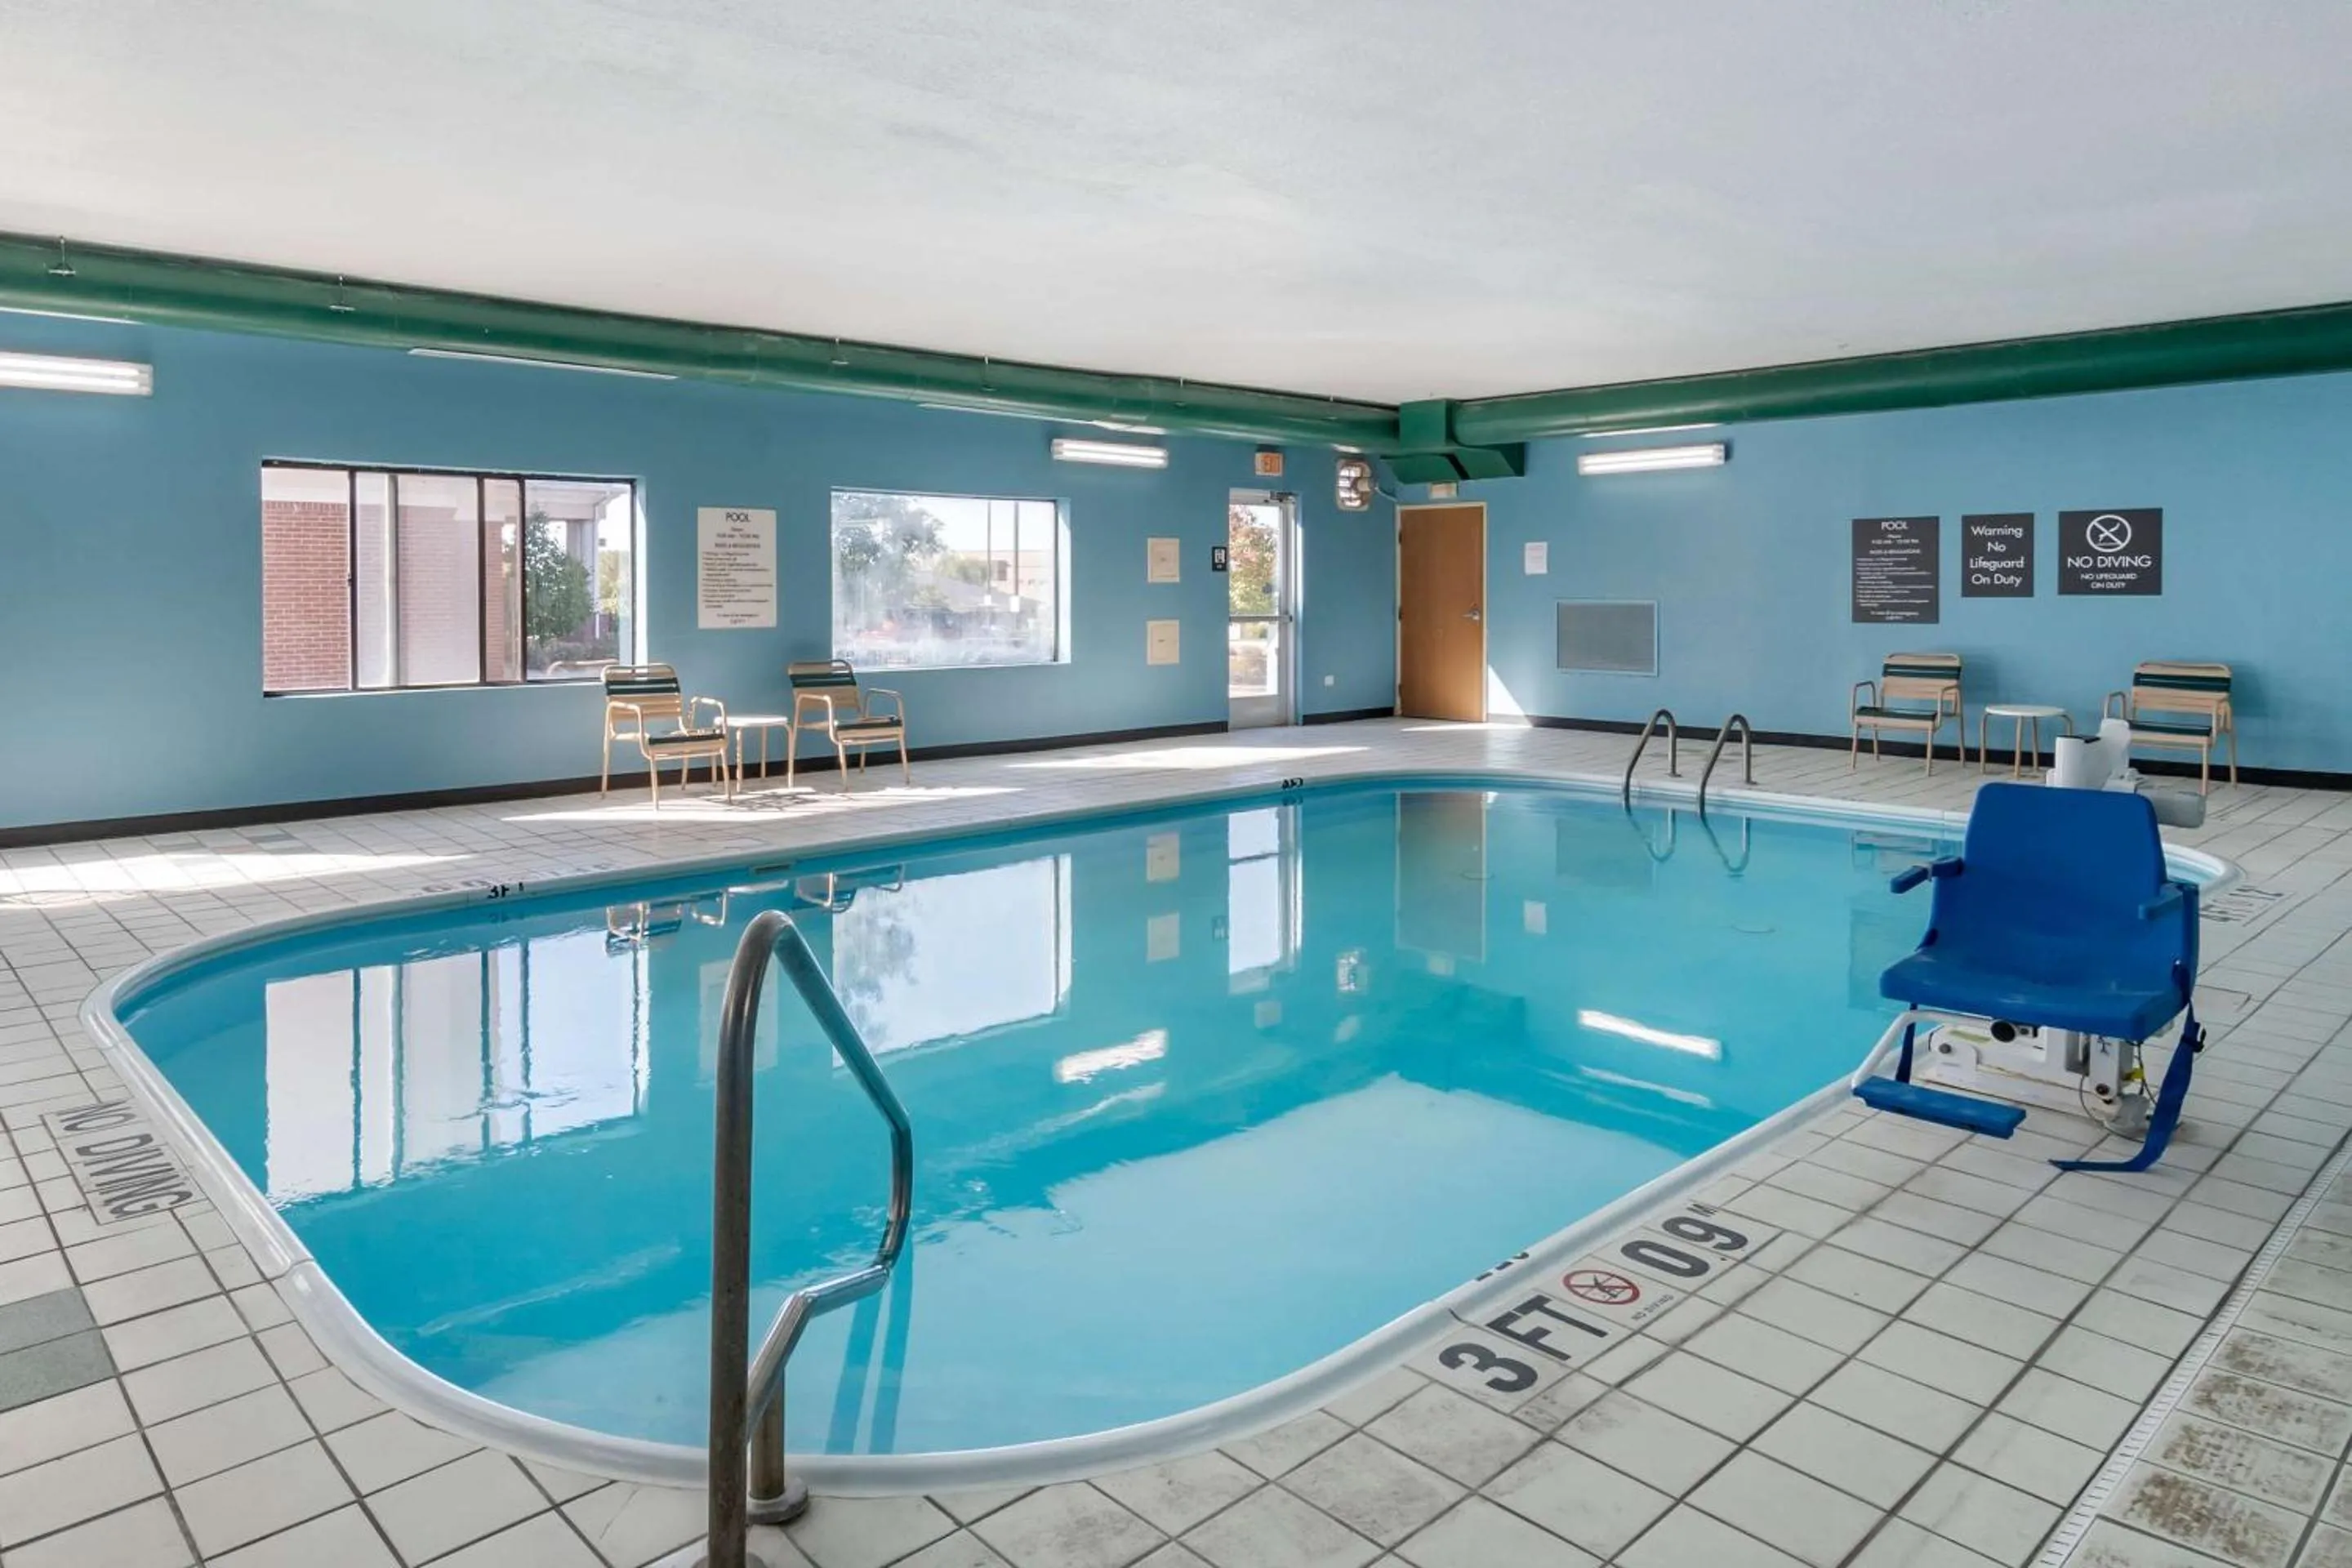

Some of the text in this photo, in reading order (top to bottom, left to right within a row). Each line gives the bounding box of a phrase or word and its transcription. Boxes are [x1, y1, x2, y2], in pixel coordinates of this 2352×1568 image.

[725, 512, 751, 523] POOL
[1881, 521, 1909, 530] POOL
[1970, 524, 2024, 538] Warning
[1987, 541, 2007, 552] No
[1969, 555, 2025, 571] Lifeguard
[2067, 555, 2153, 568] NO DIVING
[1971, 573, 2023, 587] On Duty
[56, 1101, 137, 1132] NO
[75, 1133, 194, 1216] DIVING
[1486, 1294, 1610, 1362] FT
[1438, 1342, 1539, 1393] 3
